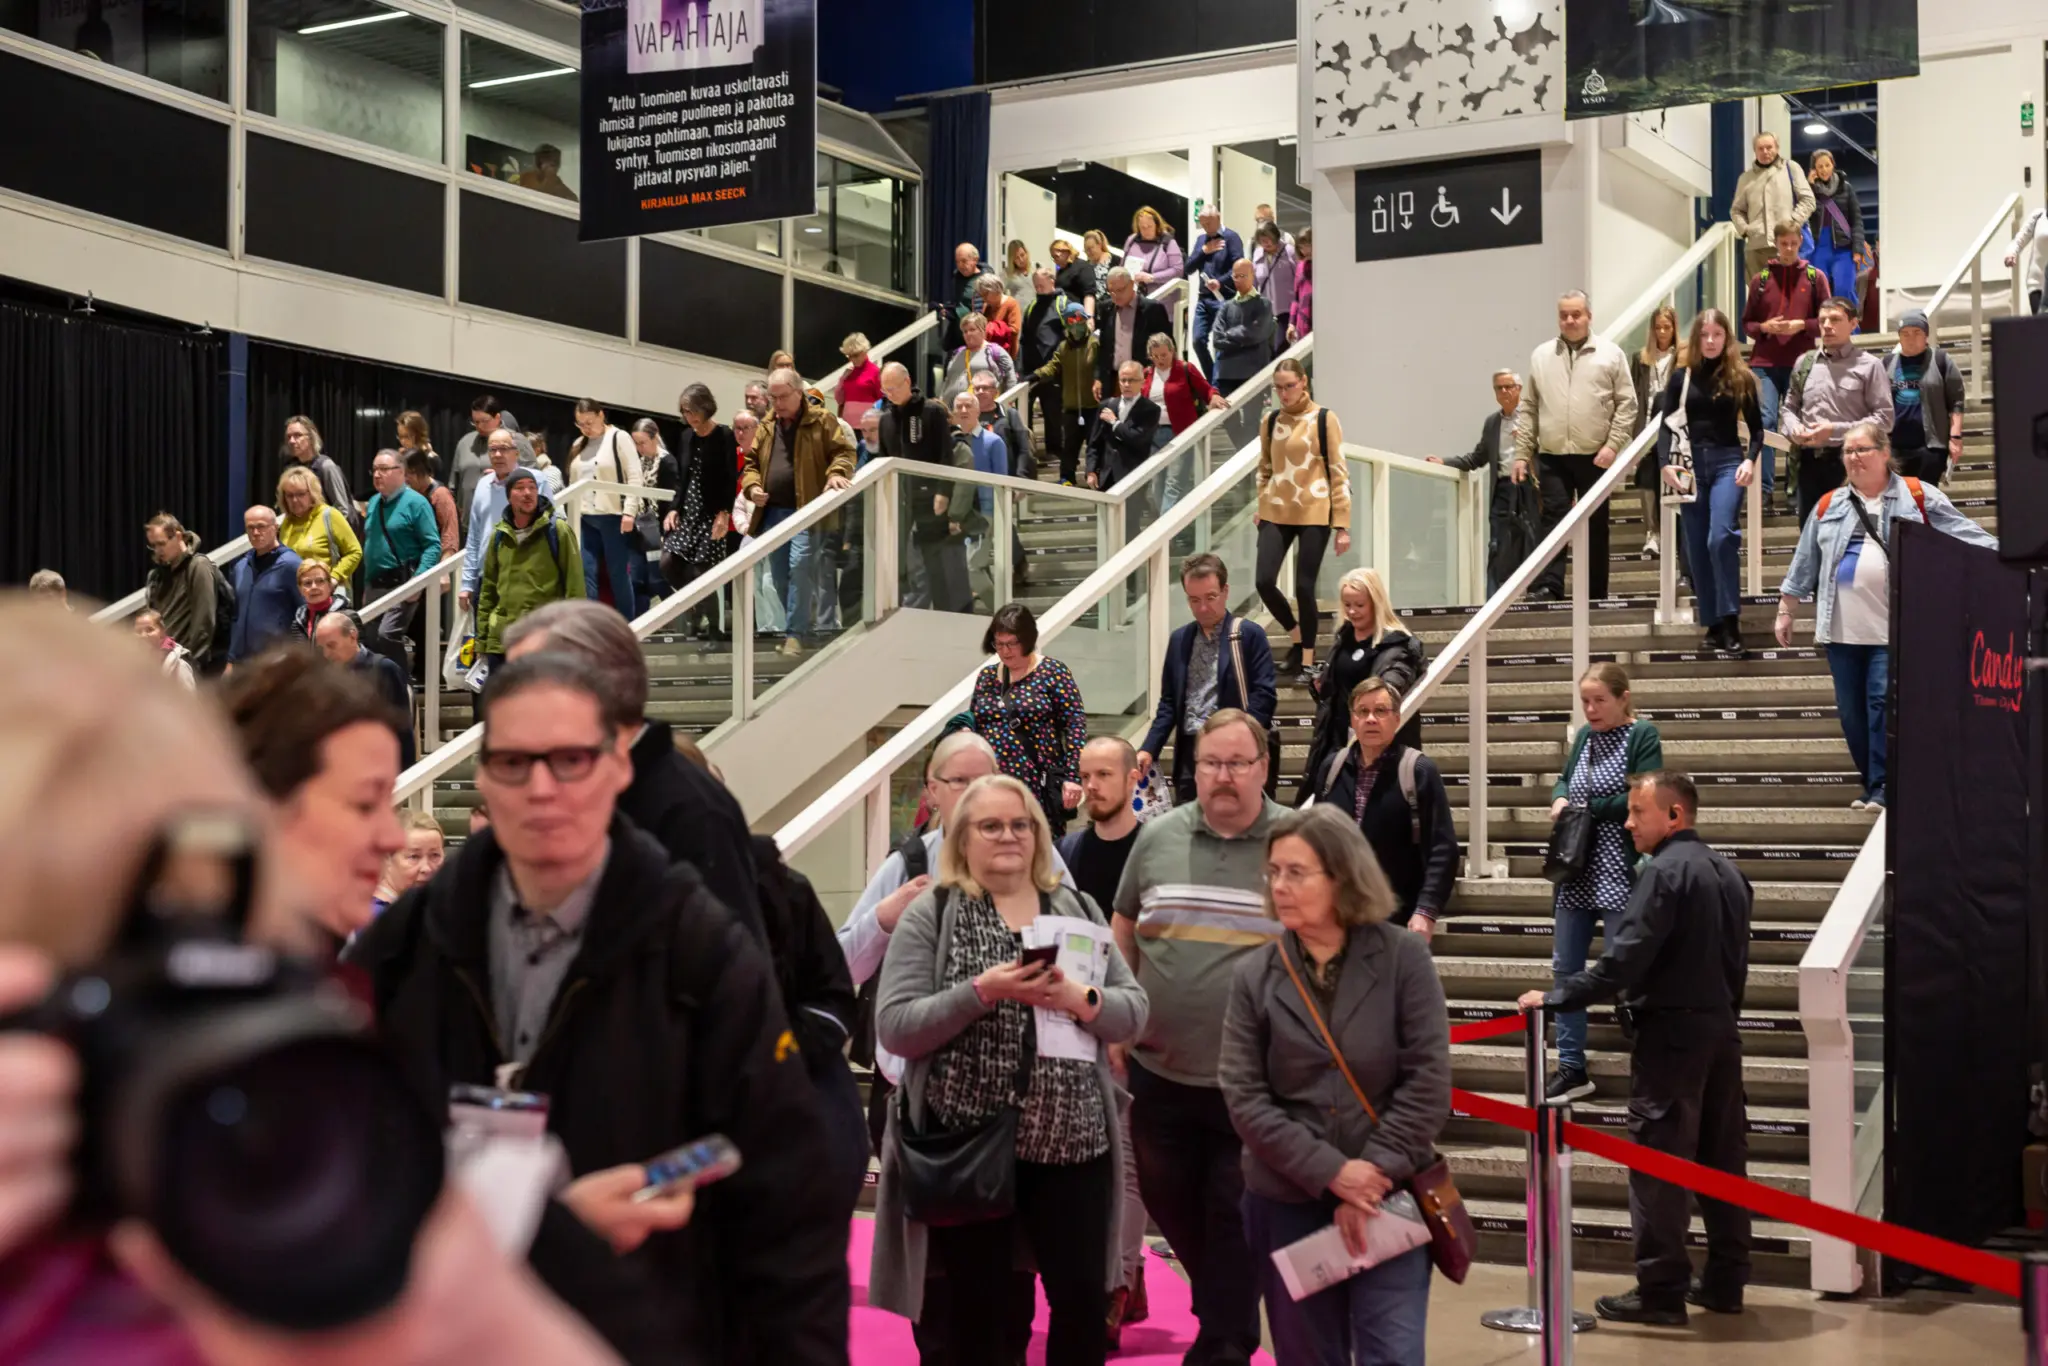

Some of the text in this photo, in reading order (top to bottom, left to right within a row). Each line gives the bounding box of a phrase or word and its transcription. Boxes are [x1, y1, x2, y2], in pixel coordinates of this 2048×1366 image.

[634, 10, 749, 55] VAPAHTAJA
[640, 89, 687, 108] Tuominen
[690, 85, 721, 100] kuvaa
[724, 71, 790, 96] uskottavasti
[1582, 95, 1606, 105] WSOY
[599, 93, 795, 133] ihmisiä pimeine puolineen ja pakottaa
[607, 133, 652, 152] lukijansa
[714, 119, 744, 137] mistä
[747, 114, 786, 135] pahuus
[615, 133, 777, 172] syntyy. Tuomisen rikosromaanit
[633, 168, 672, 190] jättävät
[675, 162, 717, 184] pysyvän
[641, 186, 747, 210] KIRJAILIJA MAX SEECK
[1970, 630, 2023, 712] Candy
[1482, 1221, 1508, 1229] ATENA
